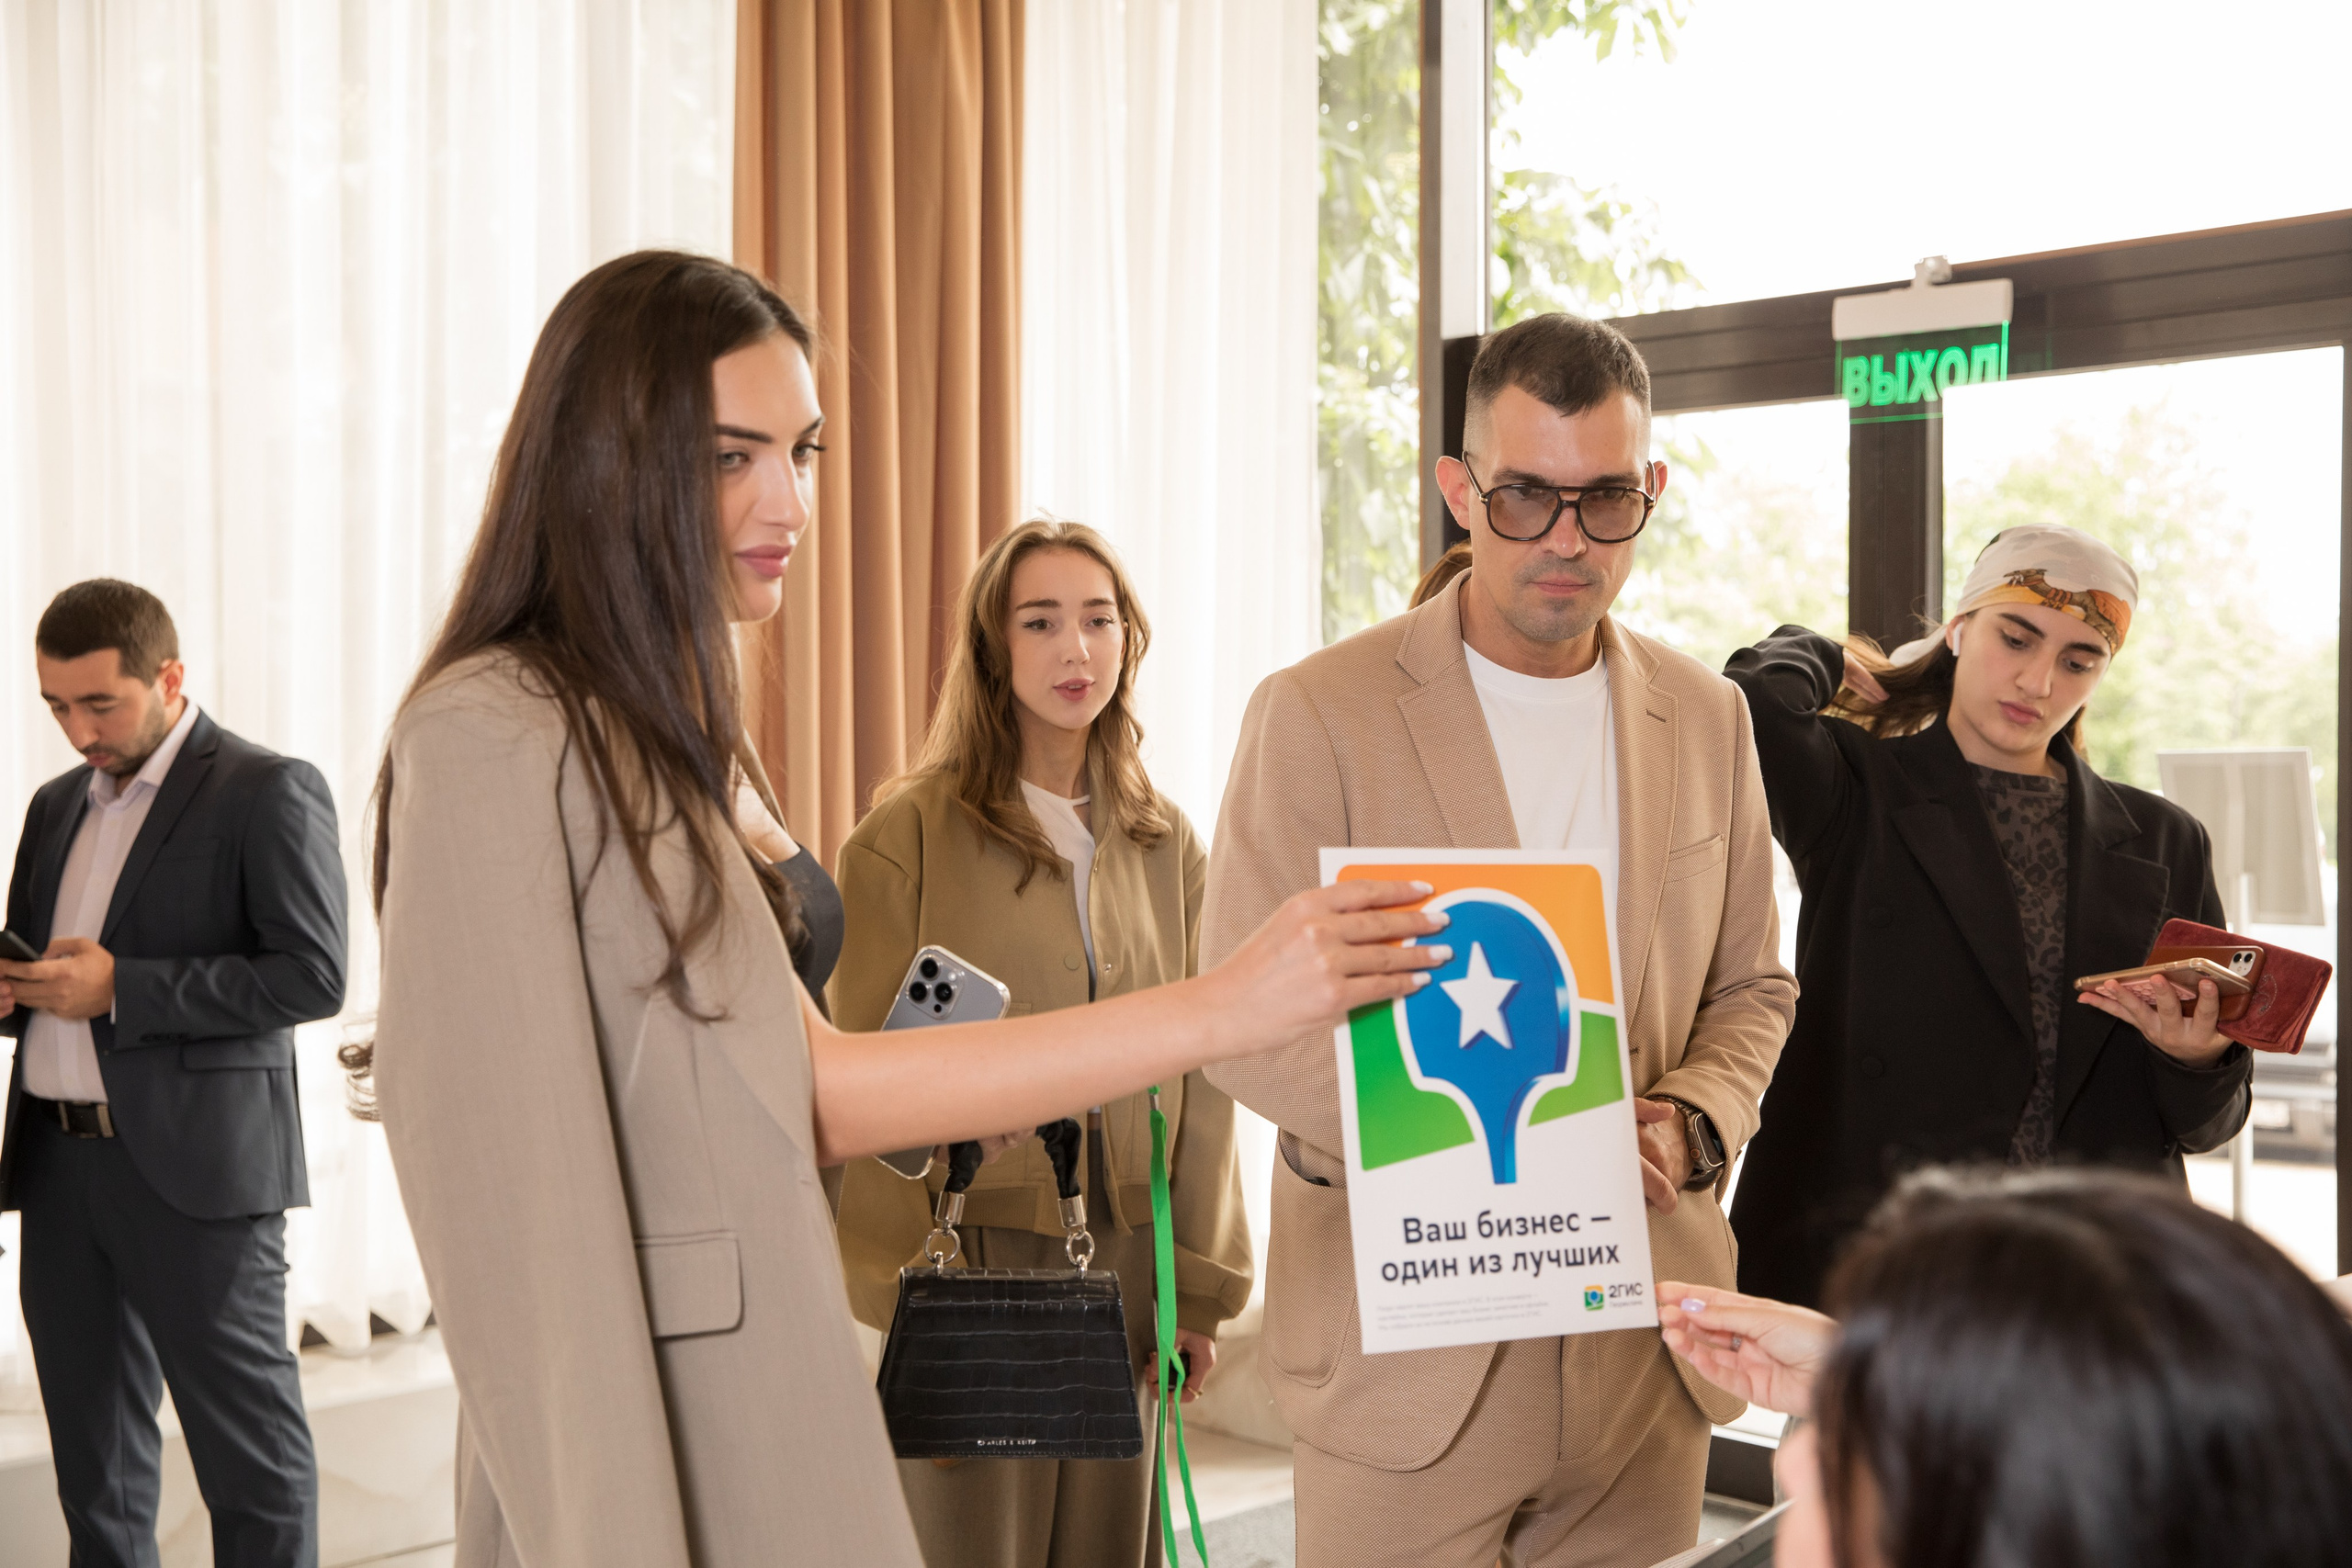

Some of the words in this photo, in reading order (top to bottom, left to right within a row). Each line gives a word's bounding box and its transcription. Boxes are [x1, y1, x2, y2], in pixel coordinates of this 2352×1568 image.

[1402, 1217, 1467, 1245] Ваш
[1477, 1209, 1580, 1239] бизнес
[1381, 1258, 1459, 1285] один
[1469, 1253, 1503, 1275] из
[1512, 1244, 1620, 1278] лучших
[1609, 1282, 1644, 1298] 2ГИС
